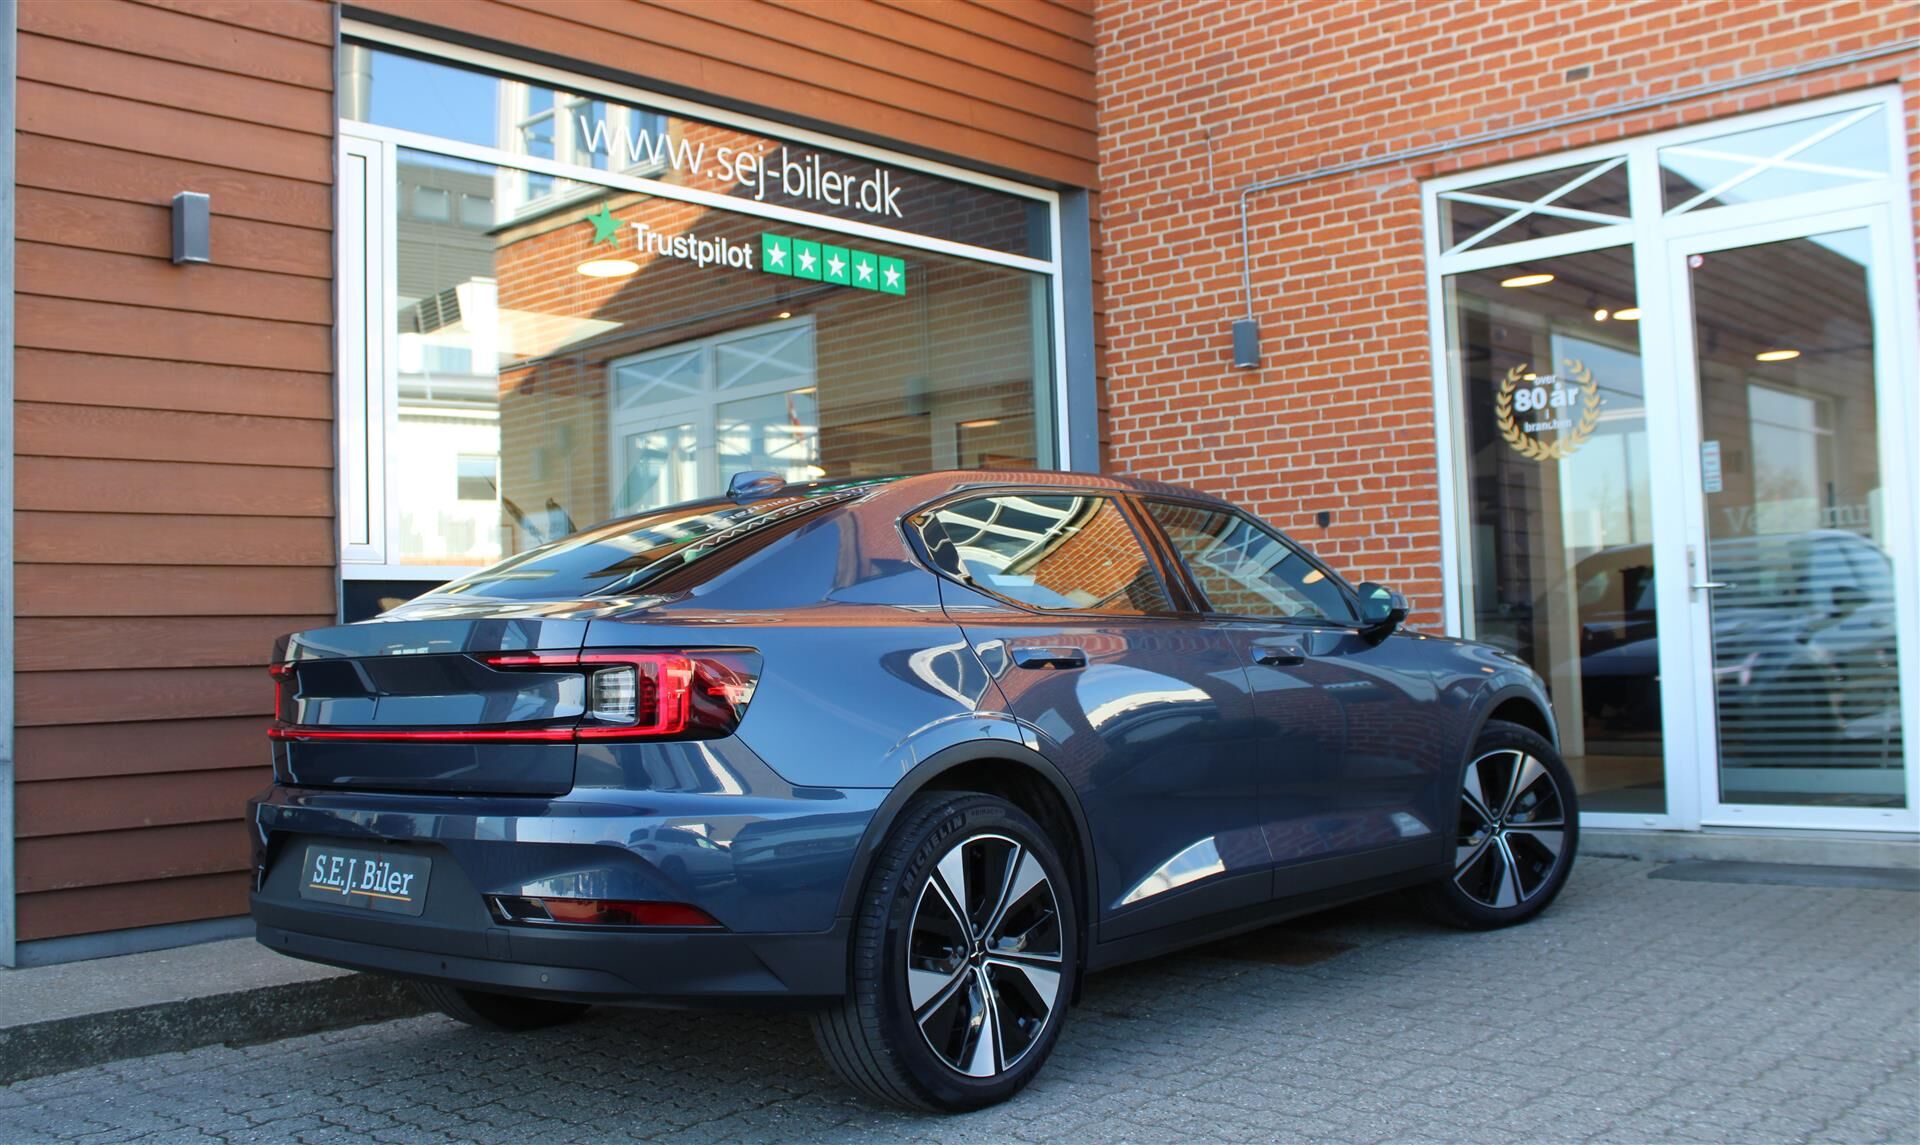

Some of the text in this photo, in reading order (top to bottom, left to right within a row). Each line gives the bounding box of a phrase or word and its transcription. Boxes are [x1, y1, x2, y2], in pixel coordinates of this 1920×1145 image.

[580, 115, 903, 218] www.sej-biler.dk
[630, 221, 754, 270] Trustpilot
[1514, 382, 1579, 412] 80 år
[312, 854, 413, 895] S.E.J. Biler
[903, 815, 963, 891] MICHELIN
